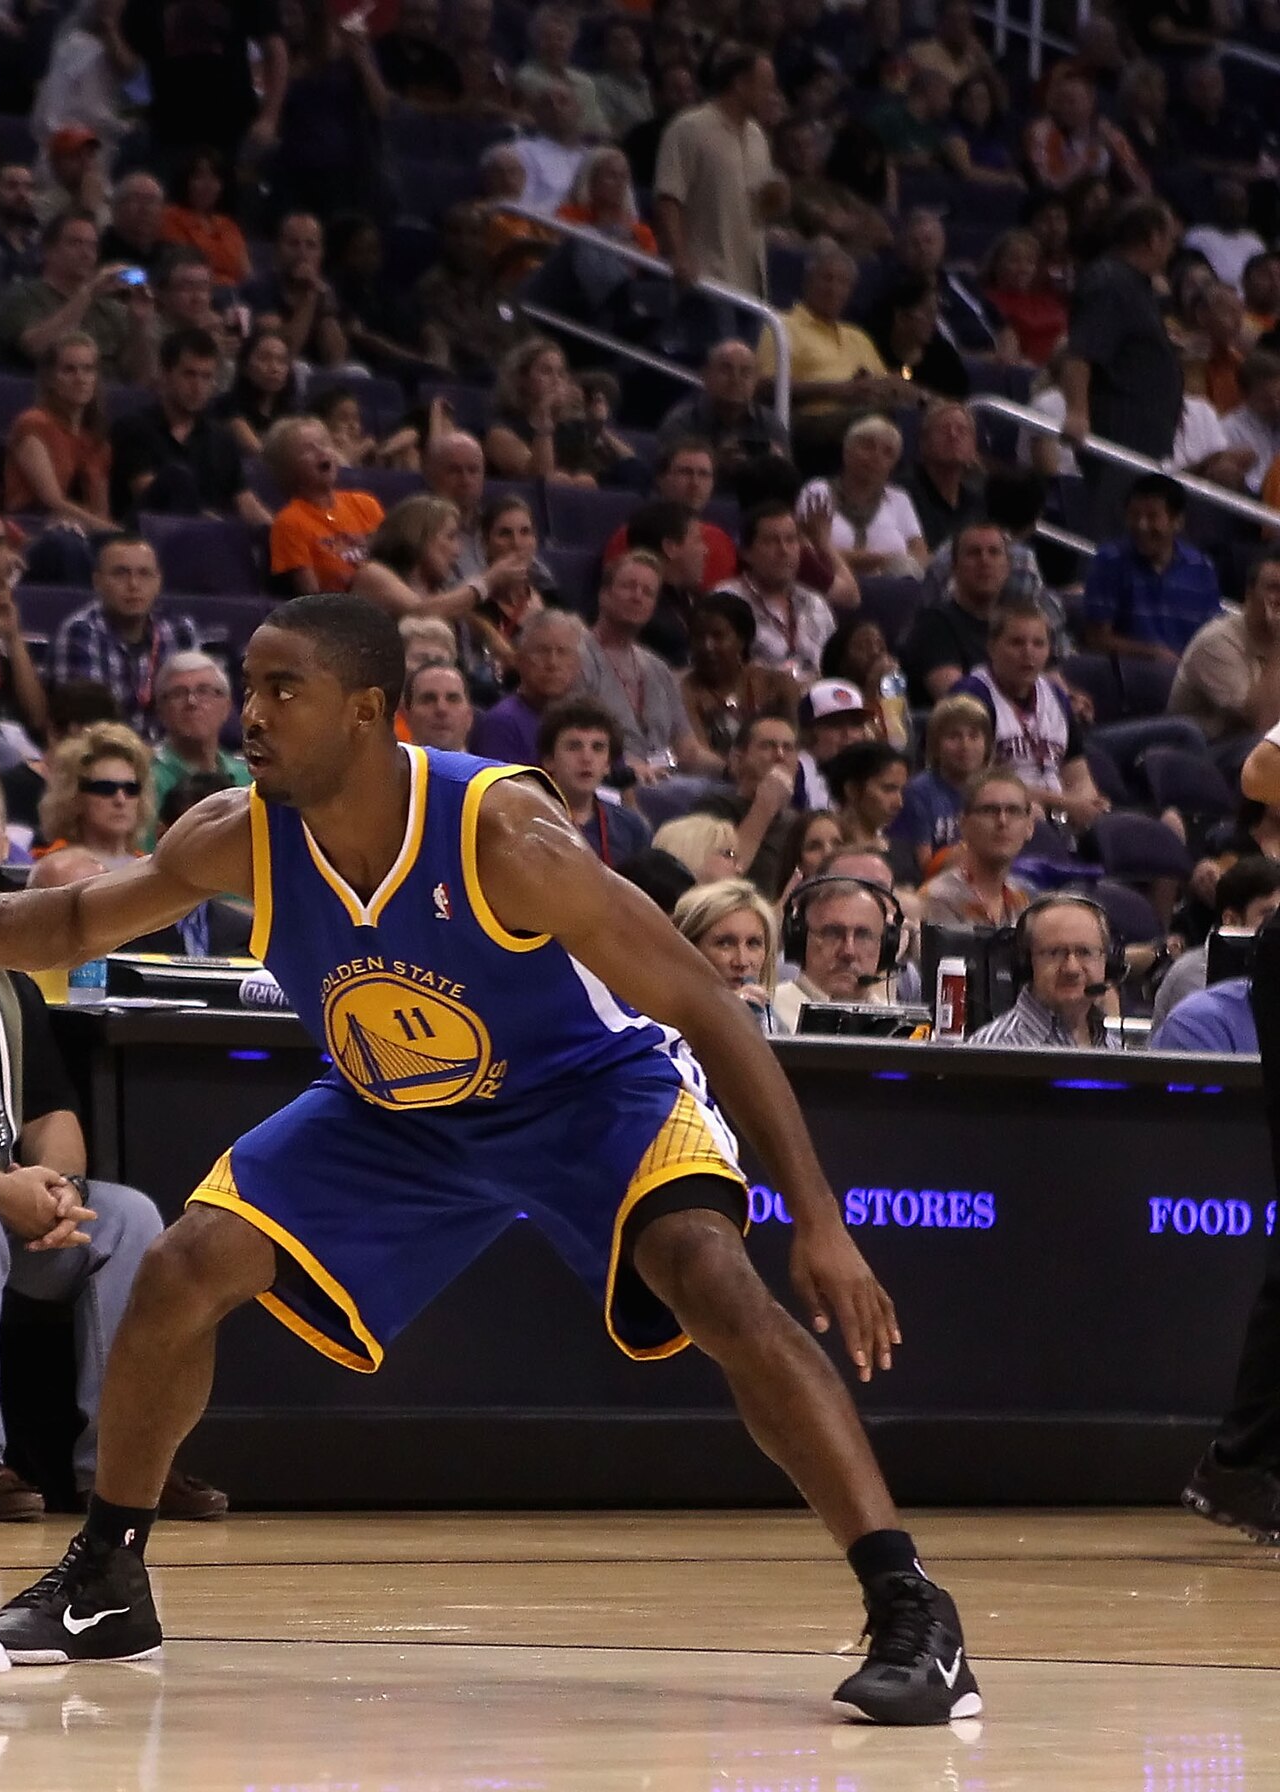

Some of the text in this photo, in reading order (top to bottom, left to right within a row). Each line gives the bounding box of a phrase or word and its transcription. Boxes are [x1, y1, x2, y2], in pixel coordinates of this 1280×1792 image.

[392, 959, 467, 999] STATE
[393, 1006, 436, 1041] 11
[844, 1187, 997, 1229] STORES
[1147, 1196, 1253, 1237] FOOD
